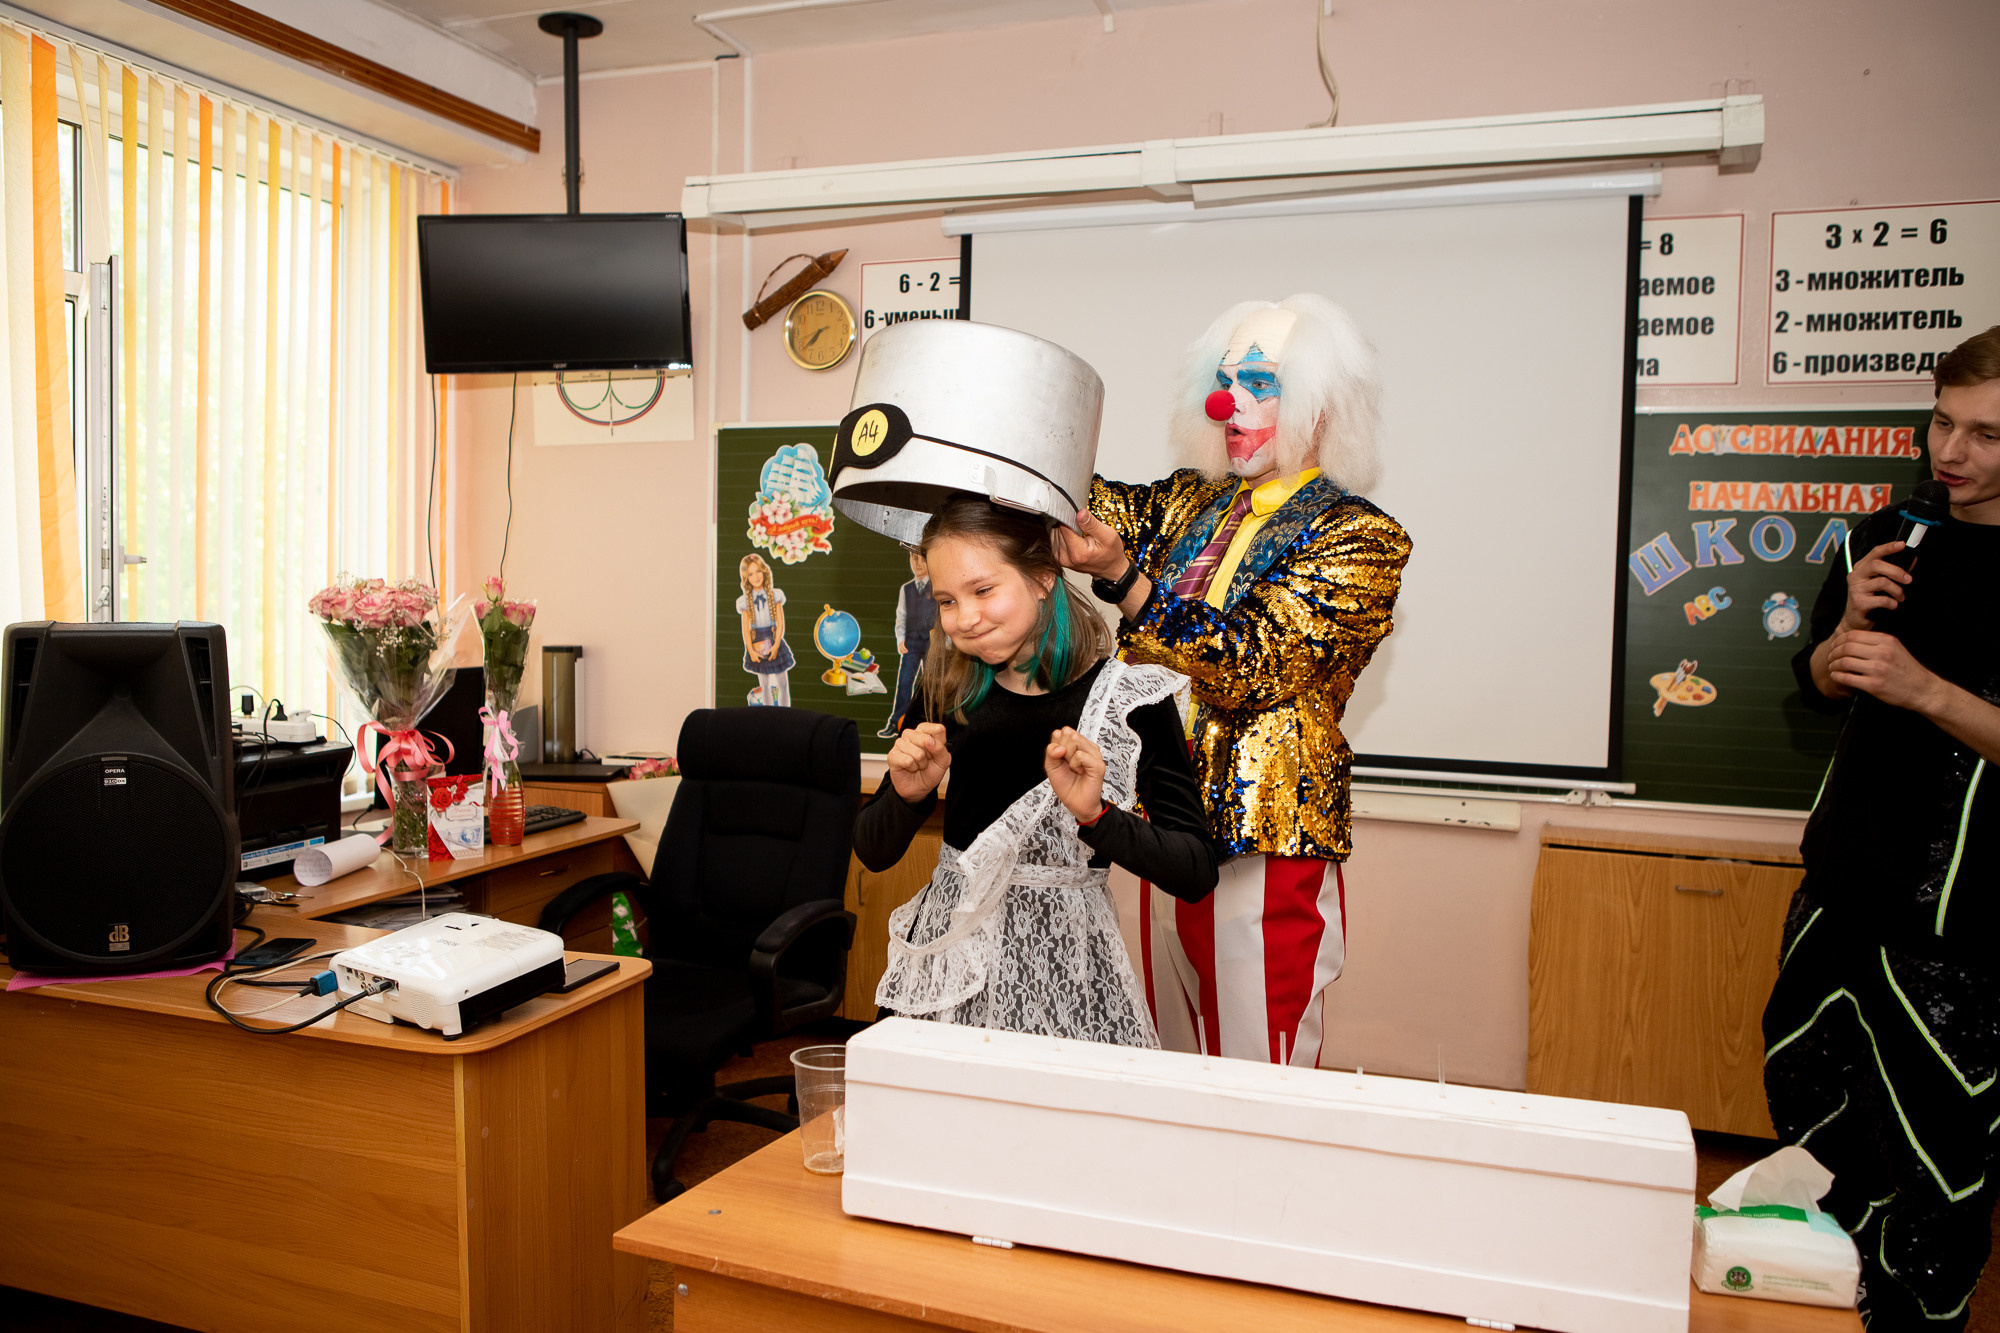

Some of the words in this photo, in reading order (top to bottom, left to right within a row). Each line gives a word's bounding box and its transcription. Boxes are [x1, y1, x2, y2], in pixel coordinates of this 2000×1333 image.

[1659, 233, 1674, 256] 8
[1825, 224, 1842, 249] 3
[1873, 221, 1890, 247] 2
[1930, 218, 1948, 244] 6
[900, 273, 910, 294] 6
[930, 271, 940, 292] 2
[1669, 424, 1717, 455] ДО
[1729, 424, 1921, 460] СВИДАНИЯ,
[1689, 481, 1893, 514] НАЧАЛЬНАЯ
[1683, 586, 1732, 625] ABC
[109, 925, 130, 942] dB
